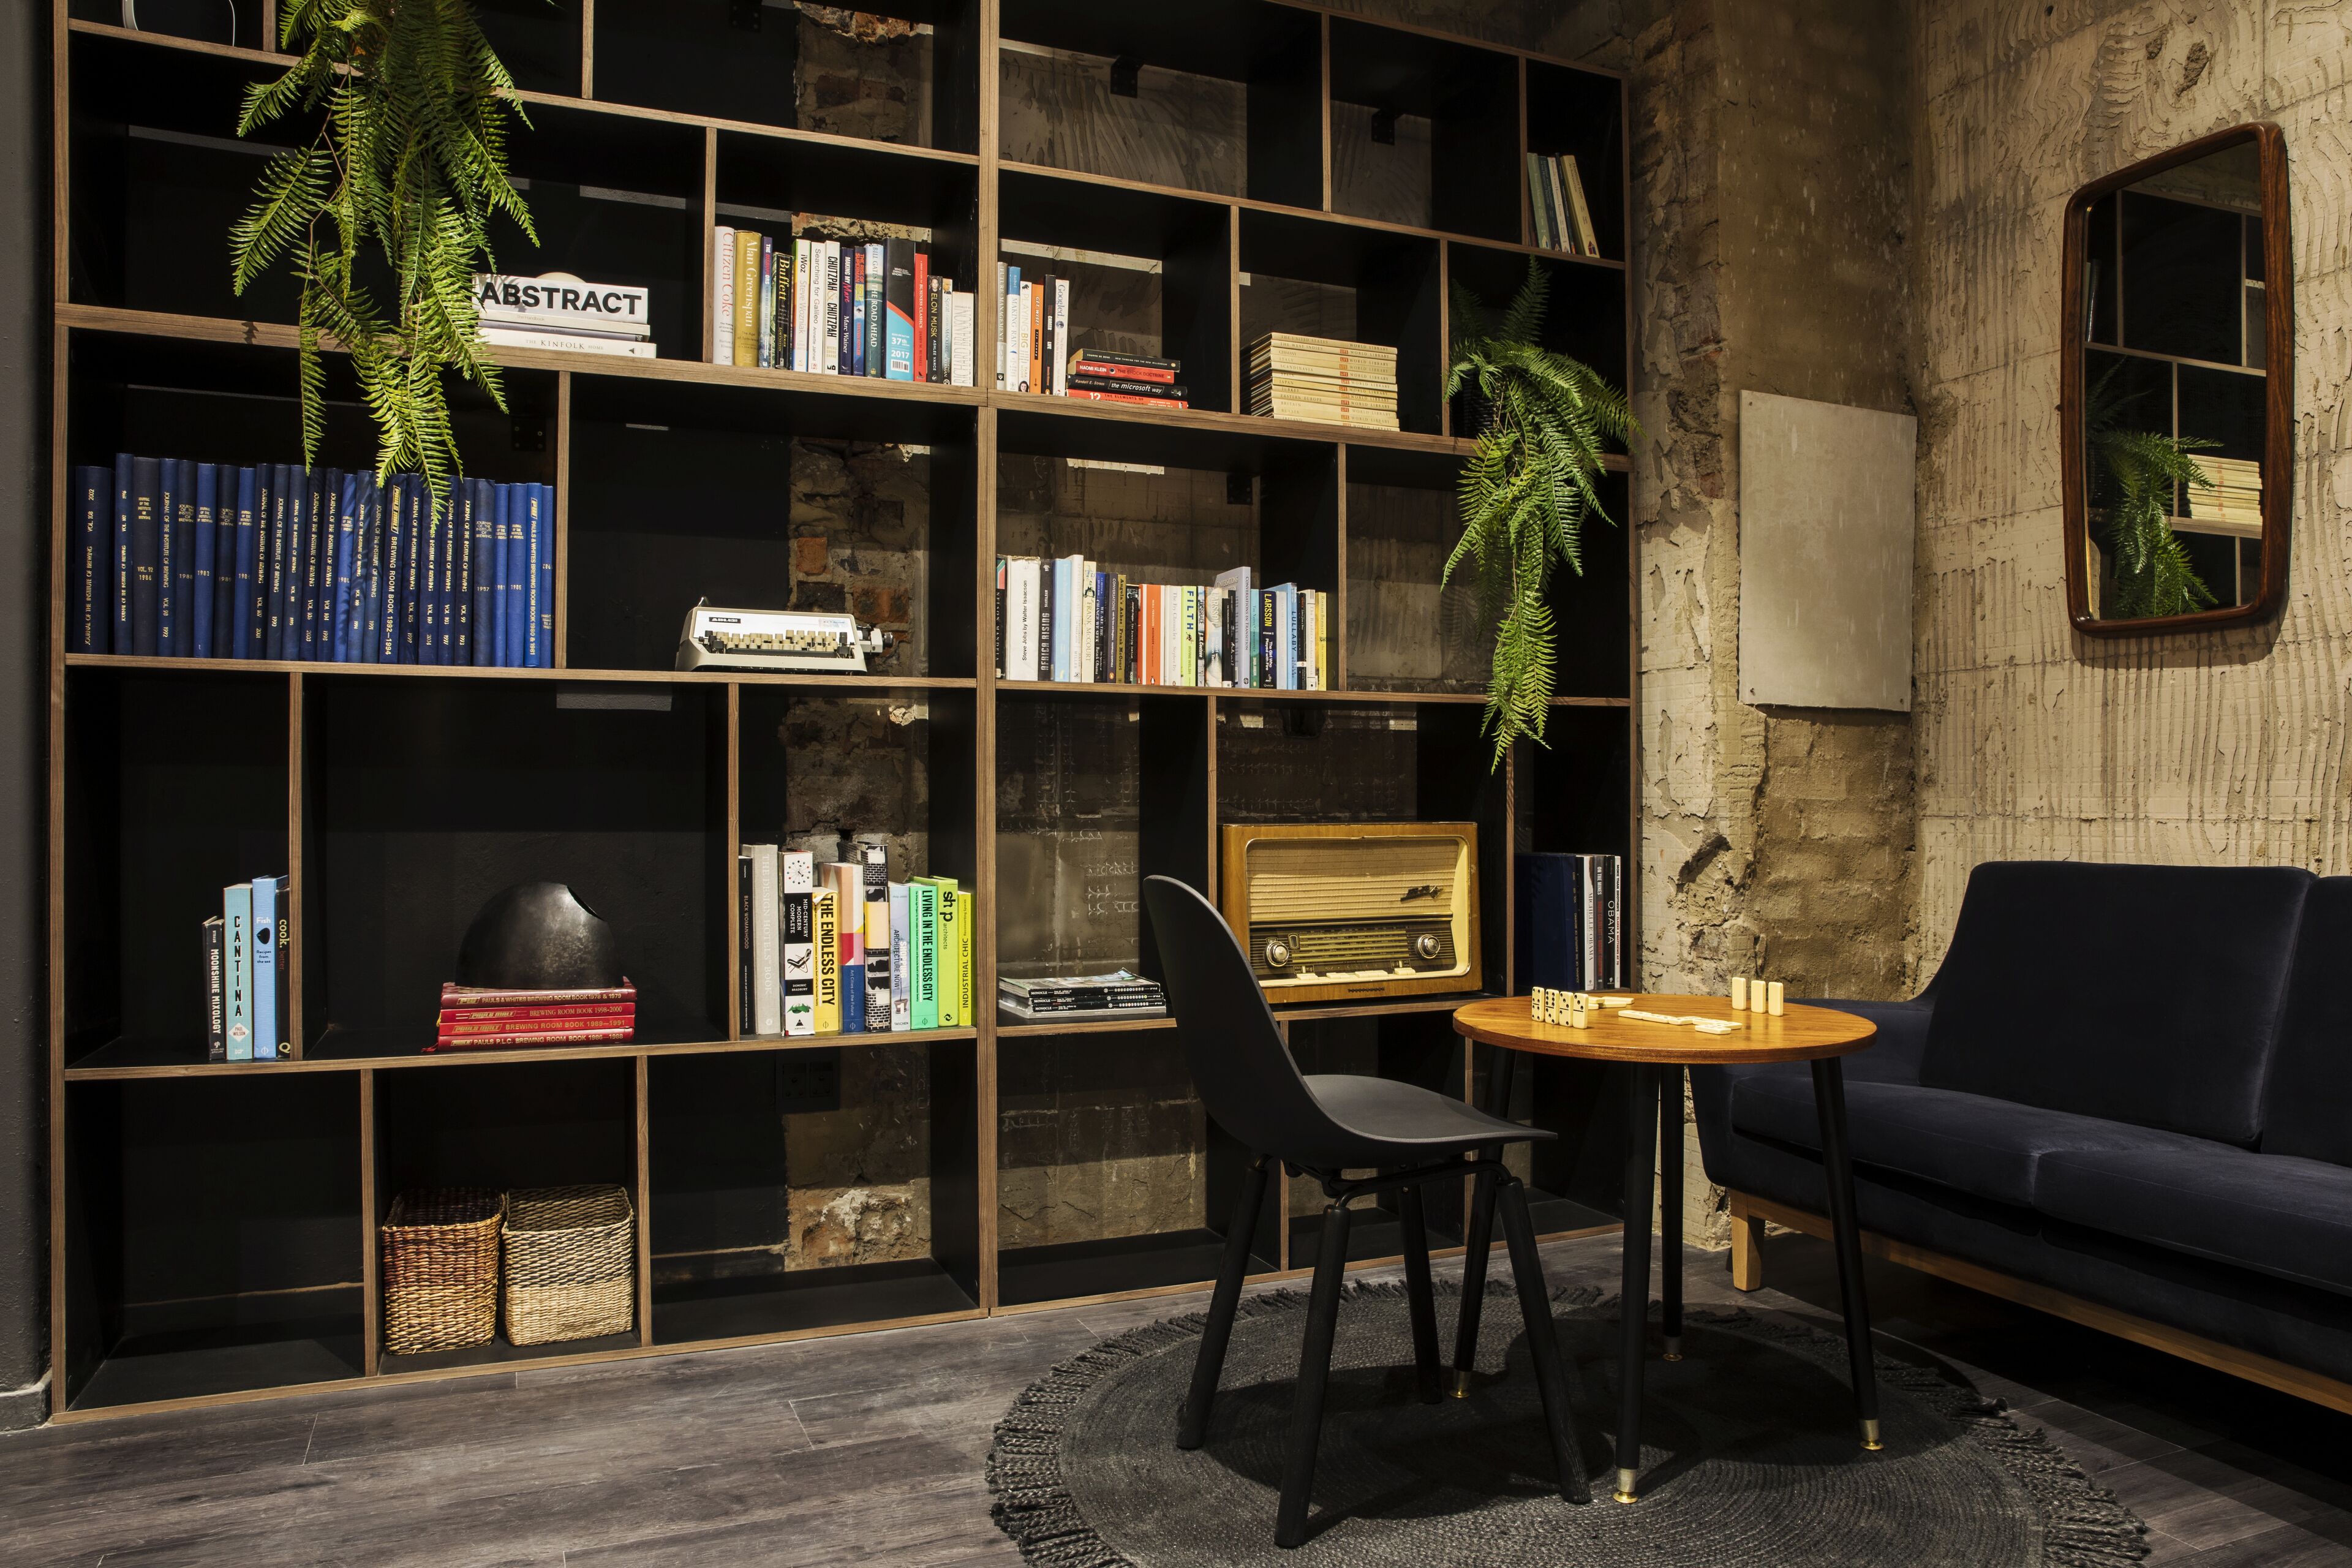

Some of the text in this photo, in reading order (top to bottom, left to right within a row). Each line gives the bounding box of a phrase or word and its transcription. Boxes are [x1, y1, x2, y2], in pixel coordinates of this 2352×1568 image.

[723, 232, 734, 280] Citizen
[746, 238, 757, 264] Alan
[779, 258, 790, 300] Buffett
[843, 282, 852, 303] Marc
[480, 282, 641, 314] ABSTRACT
[722, 284, 733, 315] Coke
[742, 268, 757, 326] Greenspan
[827, 257, 837, 337] CHUTZPAH & CHUTZPAH
[541, 341, 584, 349] KINFOLK
[891, 350, 909, 359] 2017
[821, 895, 833, 919] THE
[922, 890, 932, 918] LIVING
[279, 919, 289, 948] cook.
[923, 930, 933, 945] THE
[821, 922, 834, 975] ENDLESS
[923, 949, 932, 981] ENDLESS
[211, 949, 221, 1033] MOONSHINE MIXOLOGY
[822, 977, 835, 1006] CITY
[923, 983, 932, 1001] CITY
